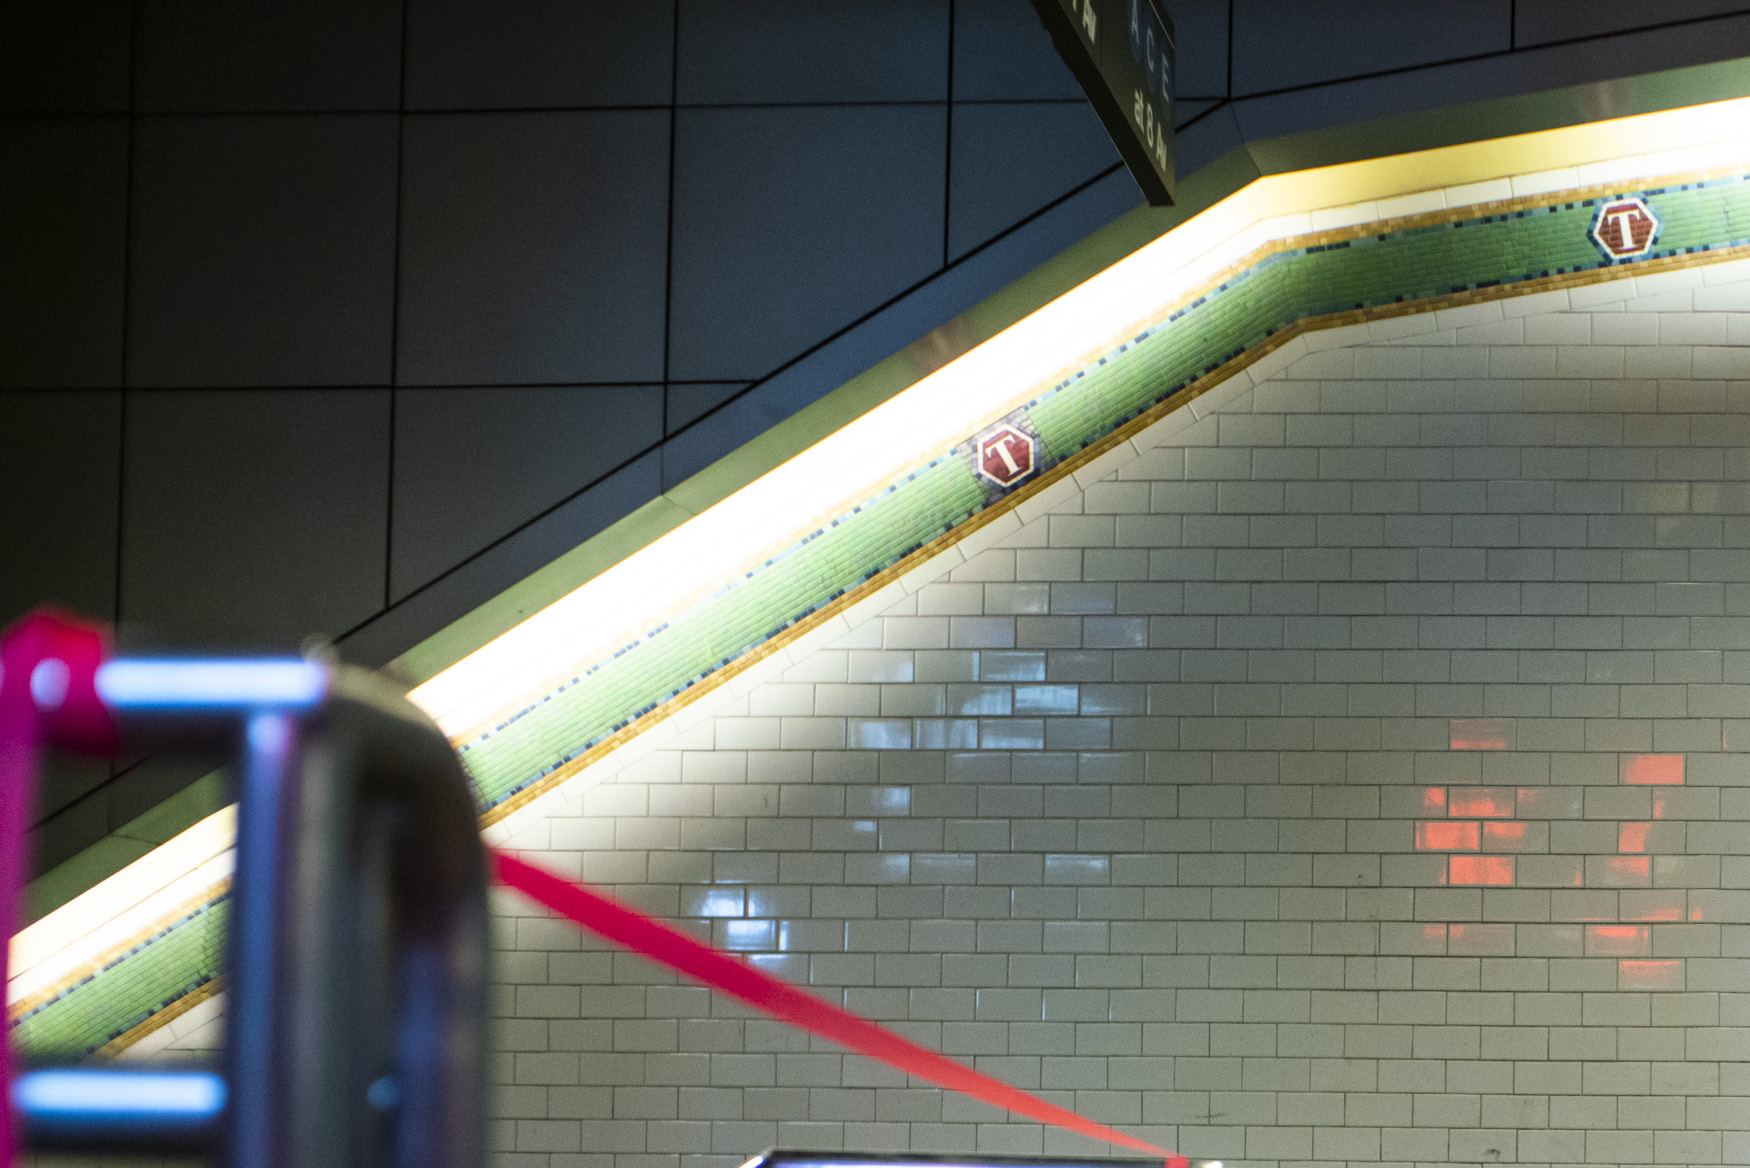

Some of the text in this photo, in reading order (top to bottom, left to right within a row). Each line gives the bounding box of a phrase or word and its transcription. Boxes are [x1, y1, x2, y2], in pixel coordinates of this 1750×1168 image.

[1146, 26, 1155, 73] C
[1162, 52, 1170, 104] E
[1146, 102, 1154, 149] 8
[1607, 209, 1641, 250] T
[985, 434, 1023, 477] T
